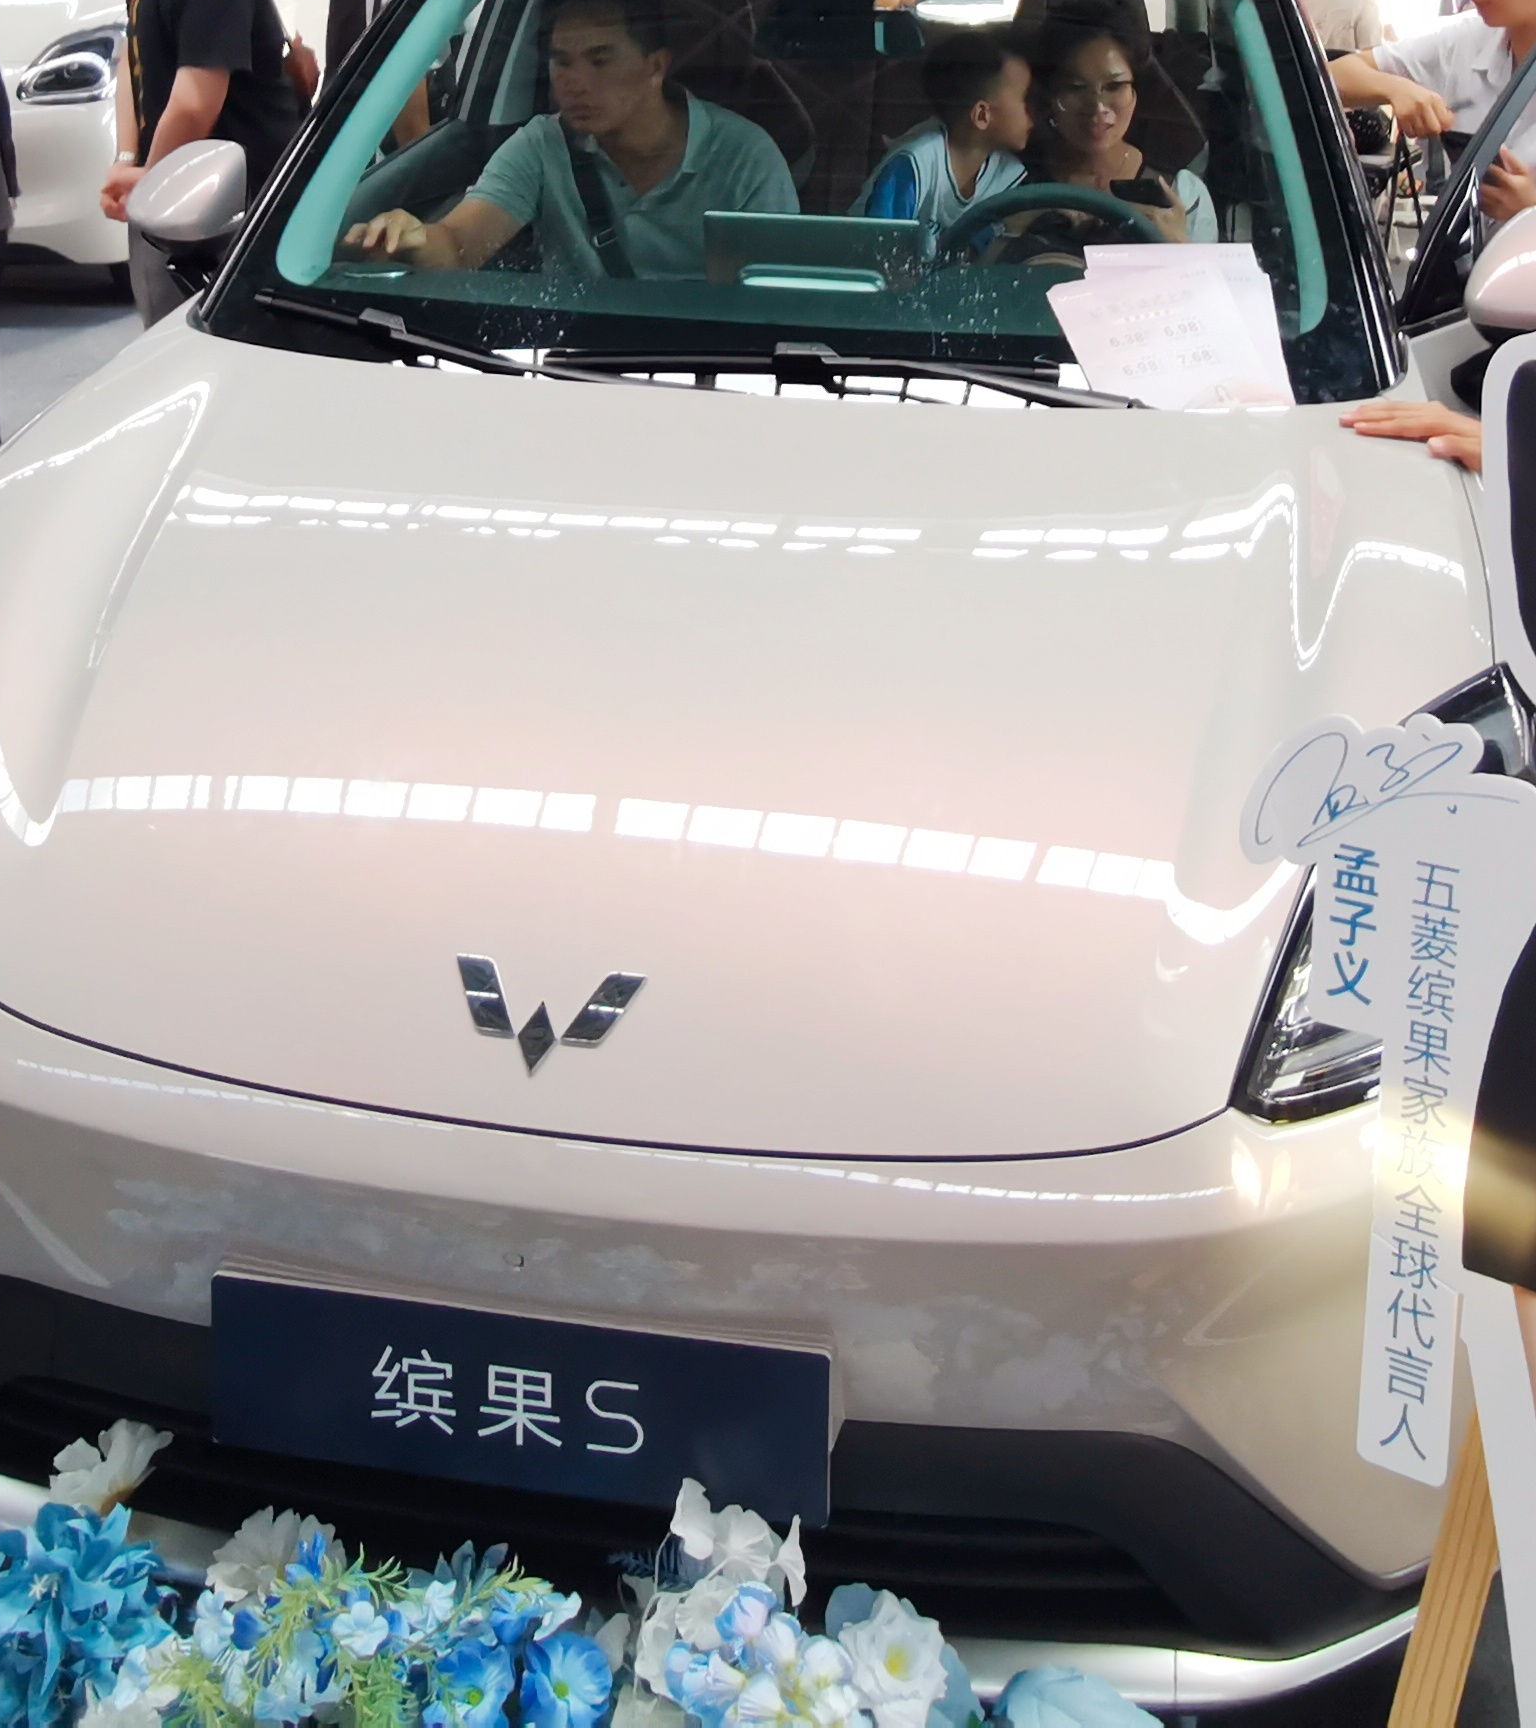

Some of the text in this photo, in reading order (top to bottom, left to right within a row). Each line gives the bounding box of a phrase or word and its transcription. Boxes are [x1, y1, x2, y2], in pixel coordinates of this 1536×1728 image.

[1325, 842, 1381, 1006] 孟子义
[1378, 859, 1462, 1463] 五菱缤果家族全球代言人
[369, 1344, 645, 1455] 缤果S
